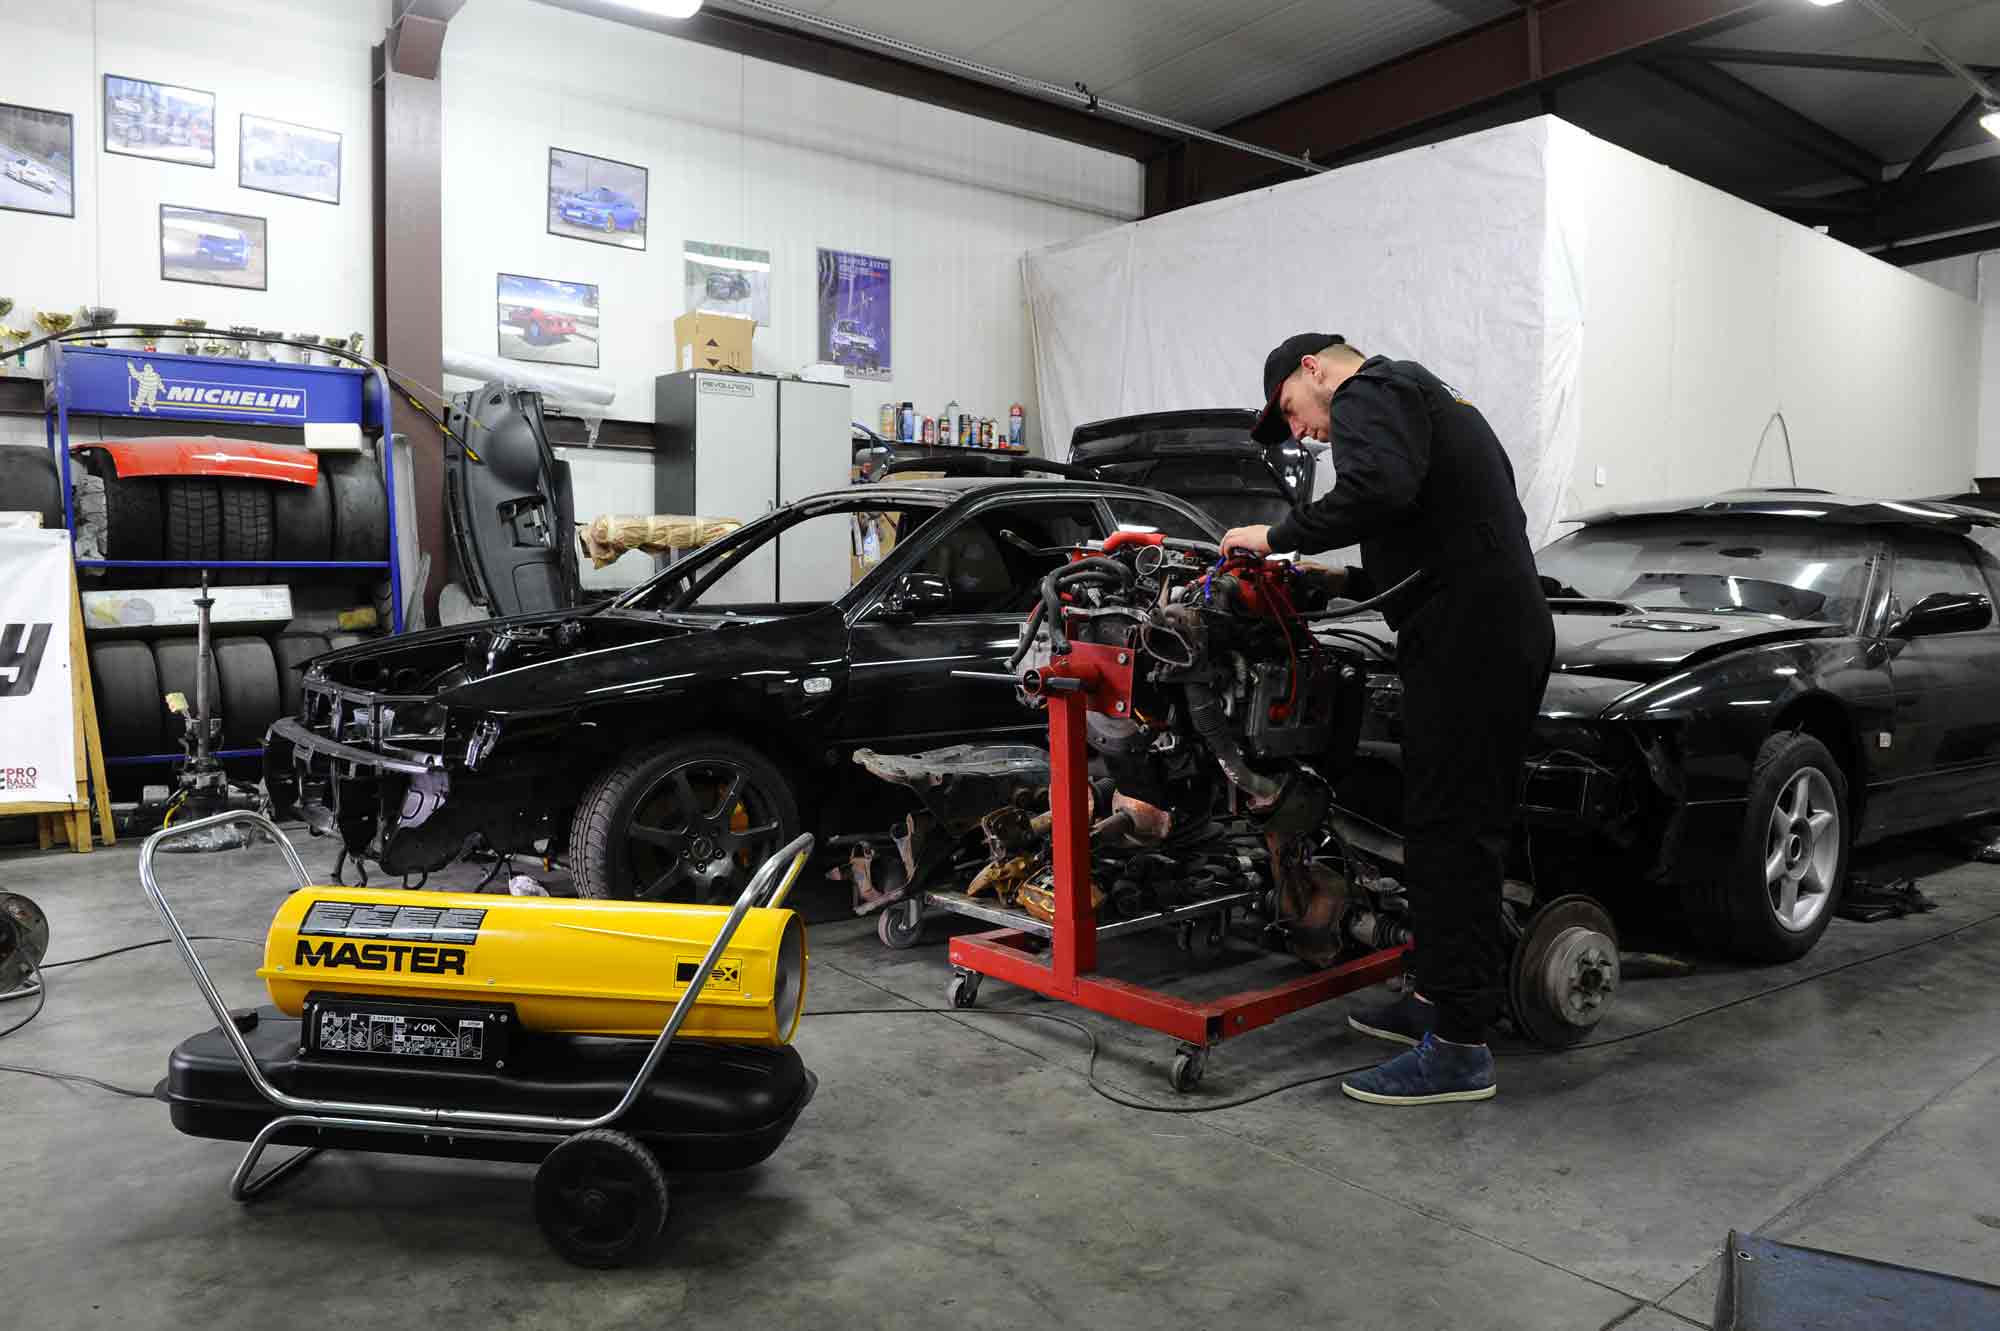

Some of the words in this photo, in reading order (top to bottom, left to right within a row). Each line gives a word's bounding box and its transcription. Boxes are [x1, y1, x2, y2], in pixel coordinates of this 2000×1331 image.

[167, 387, 300, 408] MICHELIN
[6, 767, 37, 778] PRO
[295, 940, 466, 975] MASTER
[421, 1023, 436, 1032] OK
